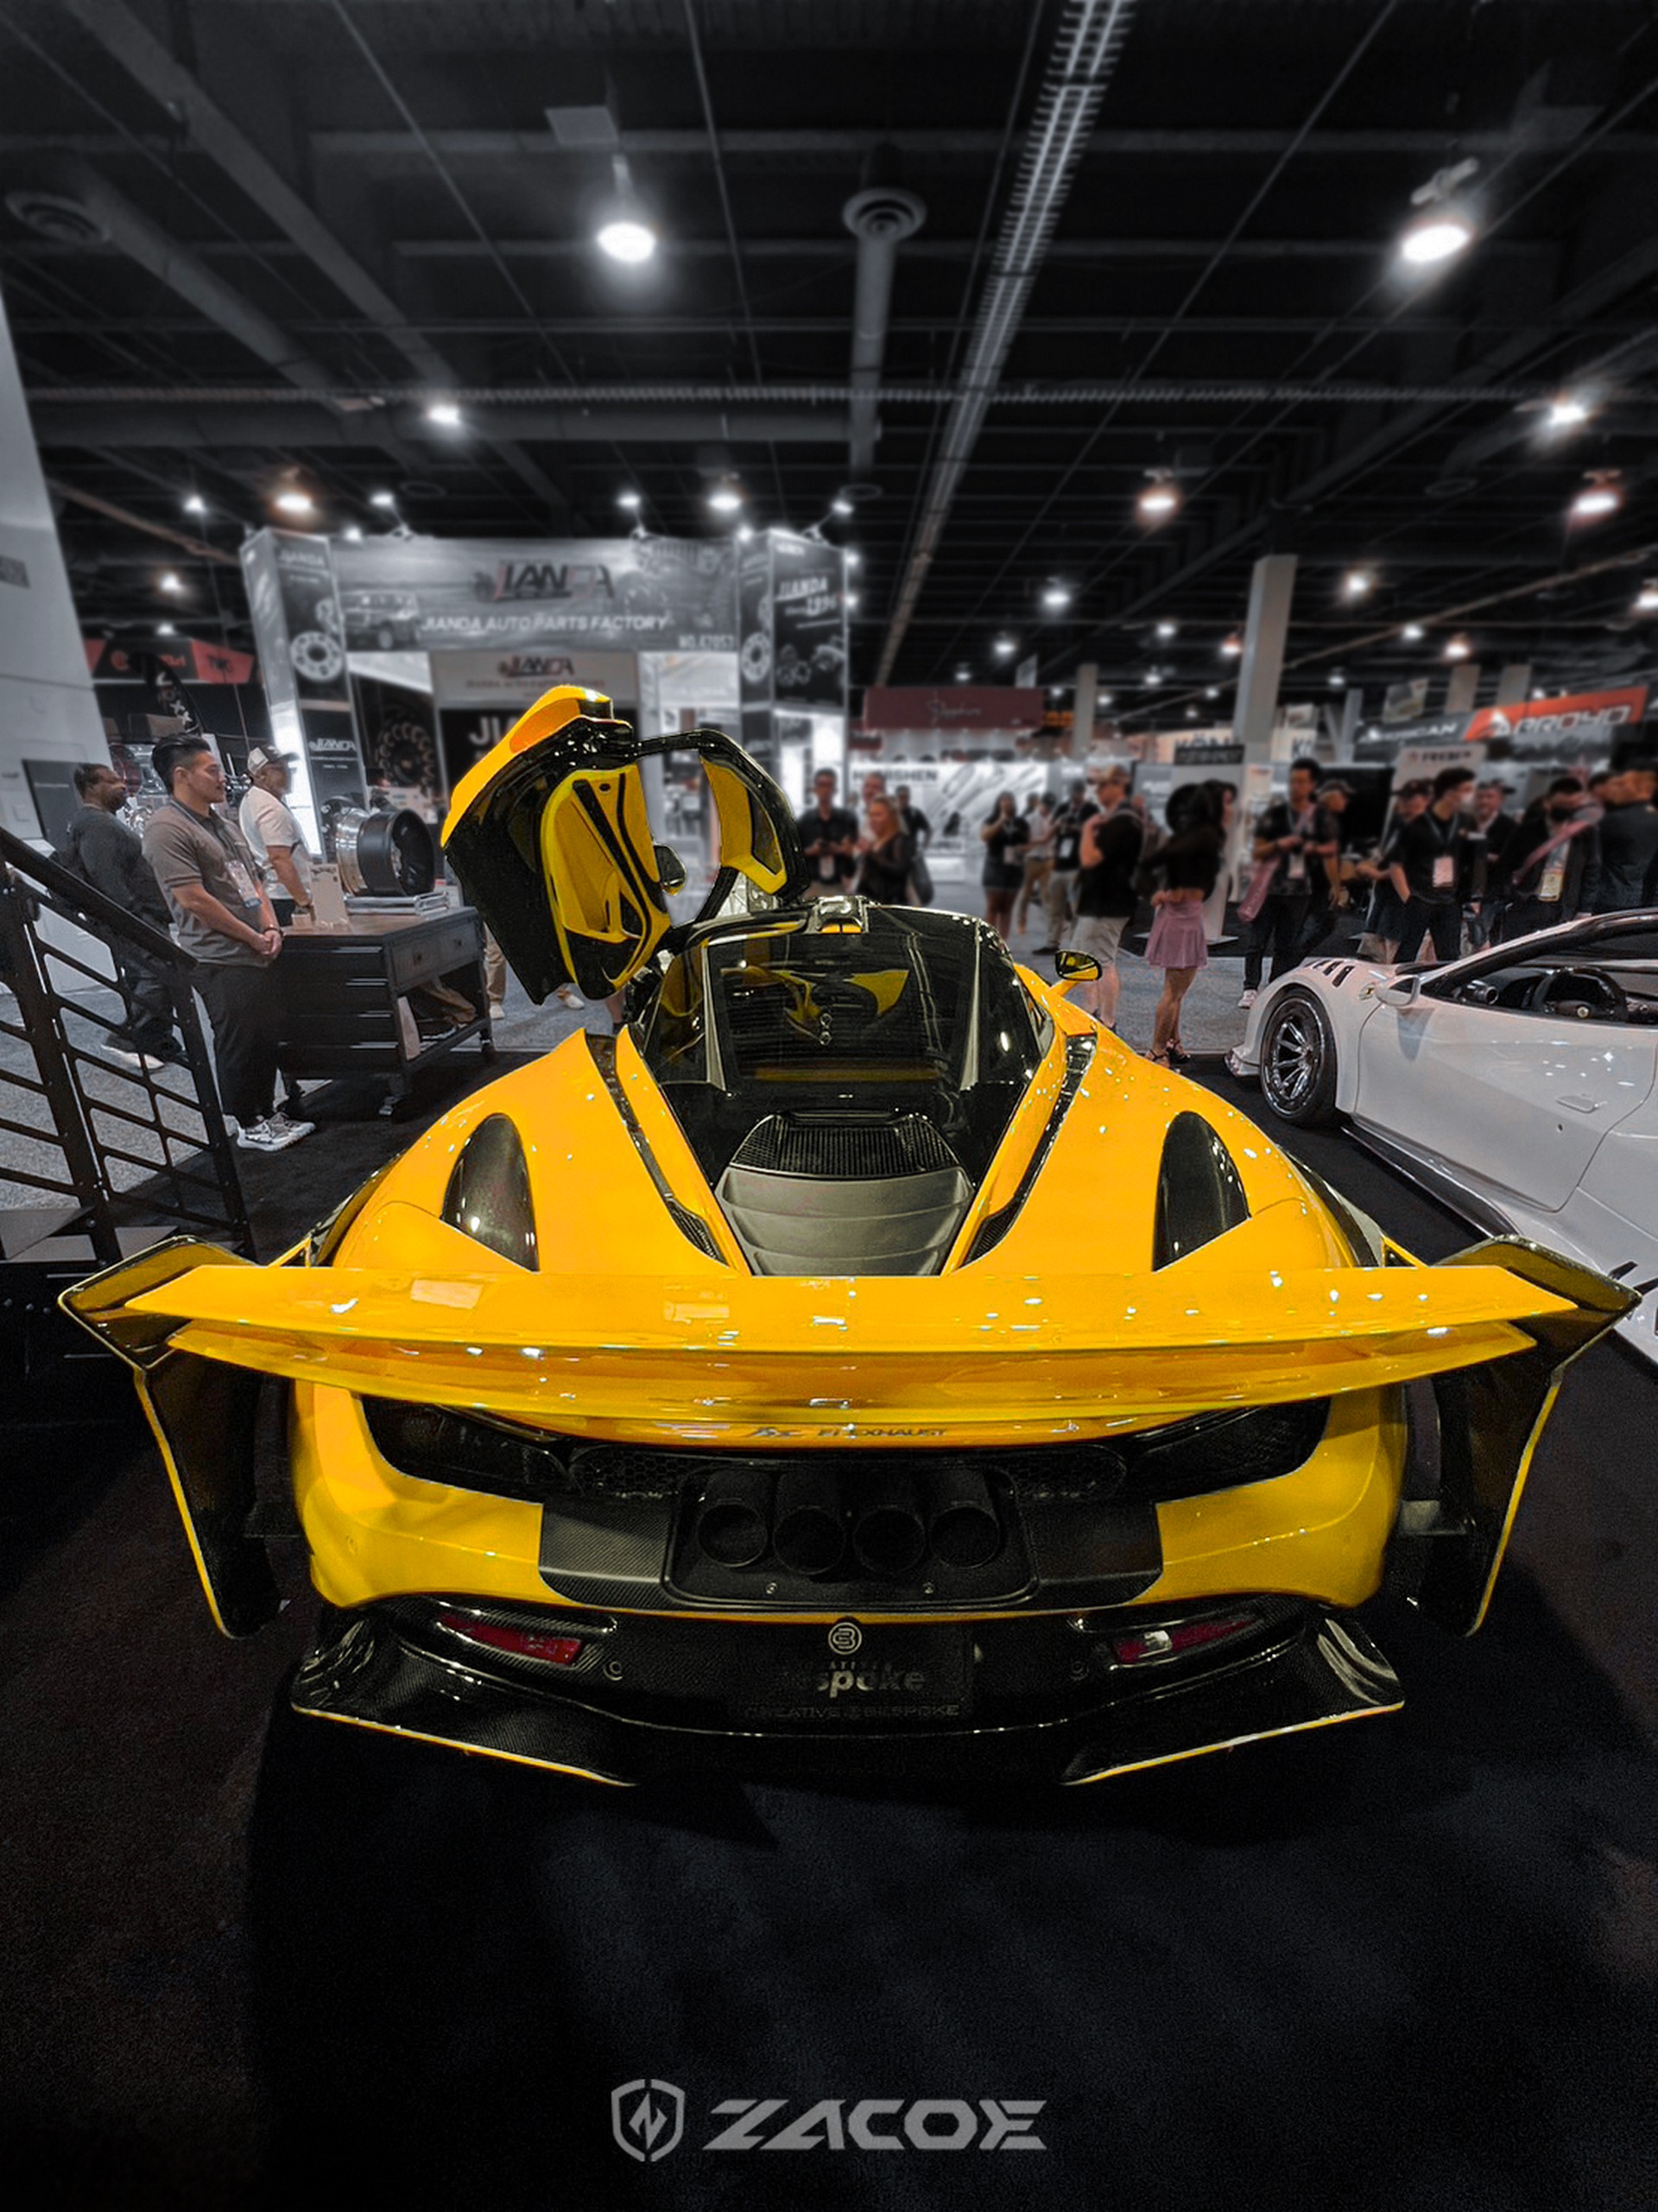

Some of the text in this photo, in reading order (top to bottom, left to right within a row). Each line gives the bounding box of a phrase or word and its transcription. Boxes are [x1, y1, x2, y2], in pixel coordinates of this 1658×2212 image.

[421, 616, 670, 631] JIANDA AUTO PARTS FACTORY
[845, 1428, 947, 1438] XHAUST
